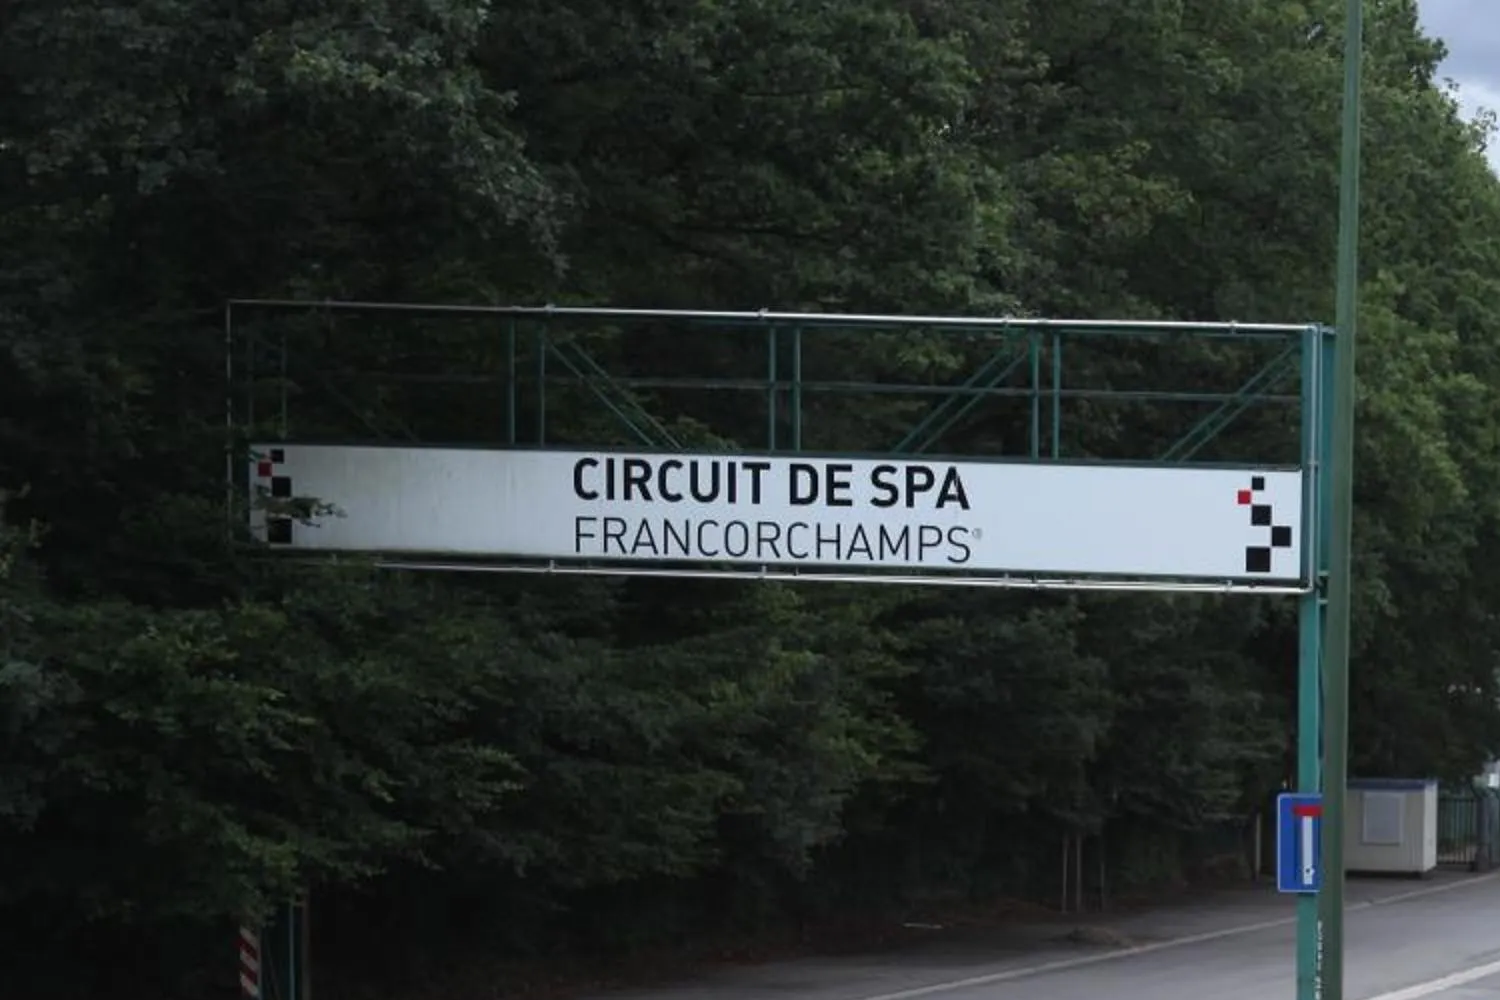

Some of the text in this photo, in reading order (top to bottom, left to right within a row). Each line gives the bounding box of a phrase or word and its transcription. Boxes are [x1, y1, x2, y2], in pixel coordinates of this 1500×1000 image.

[573, 457, 971, 511] CIRCUIT DE SPA
[575, 515, 972, 565] FRANCORCHAMPS
